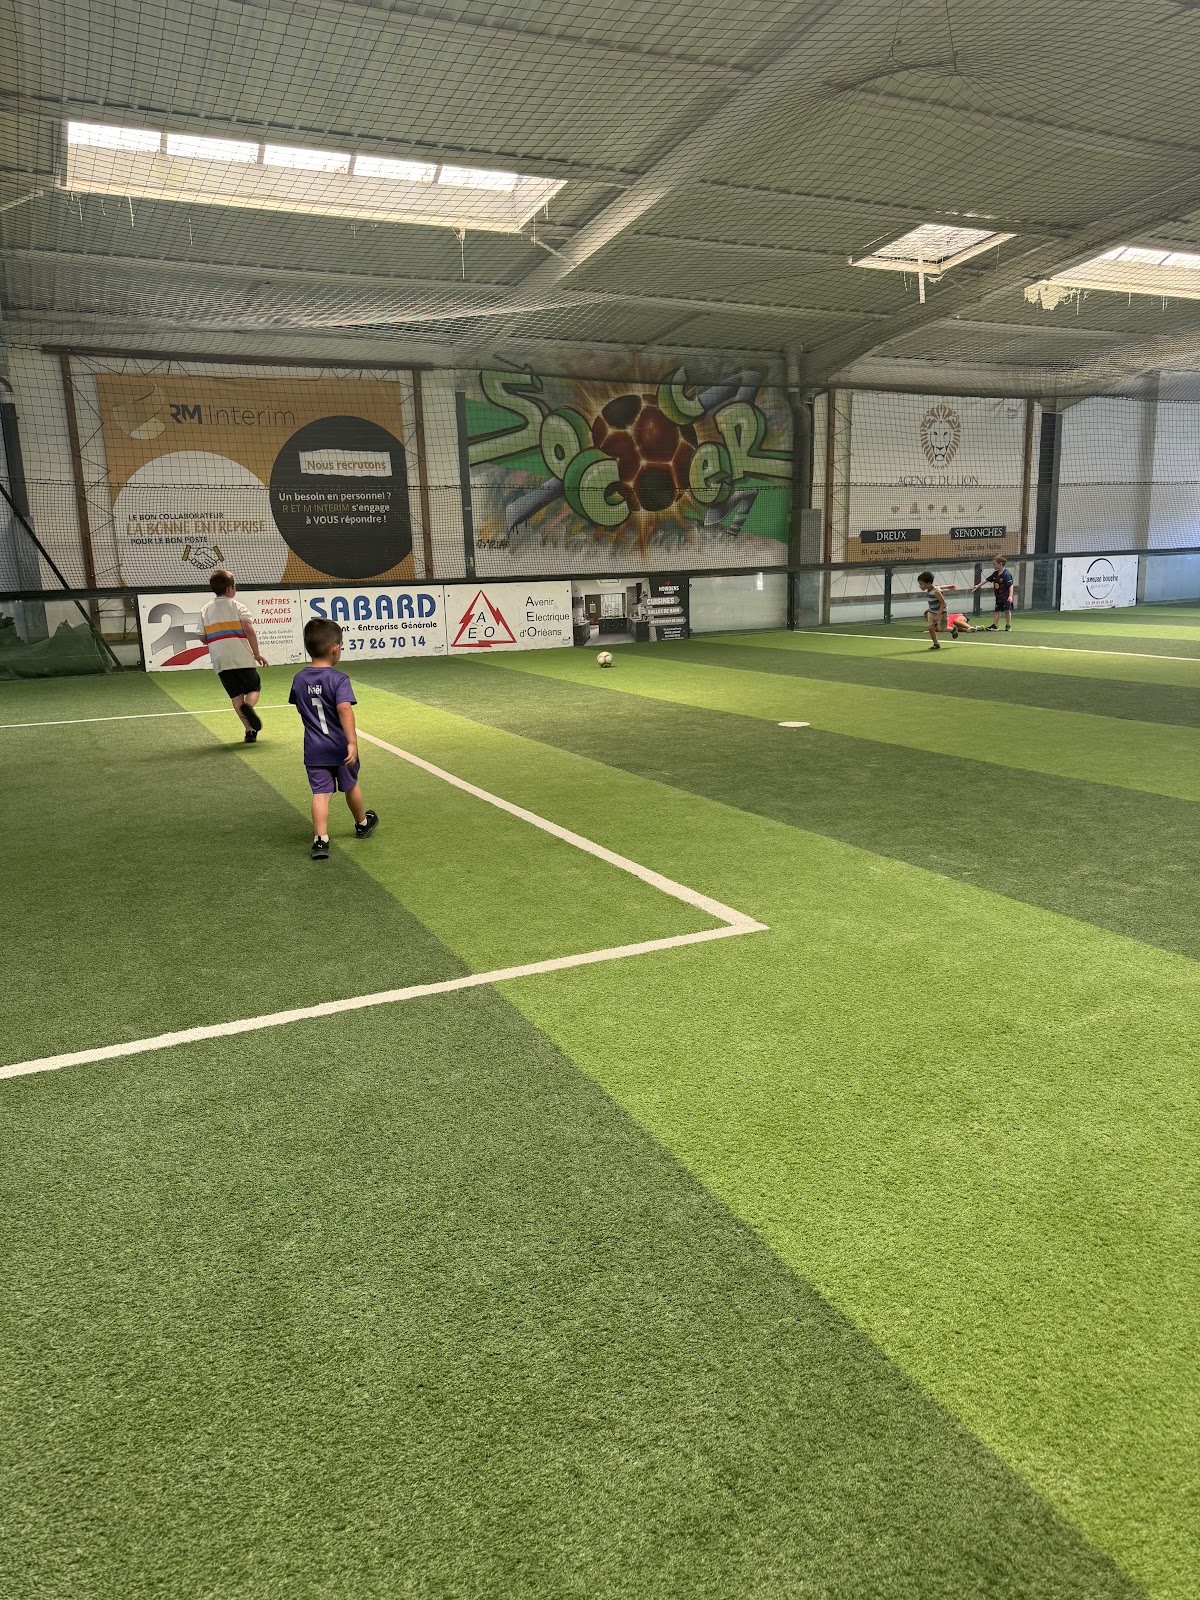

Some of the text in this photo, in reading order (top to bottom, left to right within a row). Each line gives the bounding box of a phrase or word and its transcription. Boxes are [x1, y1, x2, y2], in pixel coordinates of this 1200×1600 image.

[169, 404, 296, 426] RM Interim
[307, 461, 387, 470] Nous recrutons
[898, 475, 979, 486] AGENCE DU LION
[279, 493, 292, 501] Un
[294, 492, 325, 501] besoin
[340, 492, 385, 502] personnel
[282, 504, 390, 514] R ET M INTERIM s'engage
[159, 512, 224, 520] COLLABORATEUR
[306, 516, 312, 525] à
[313, 516, 339, 524] VOUS
[340, 515, 382, 525] répondre
[126, 520, 266, 536] LA BONNE ENTREPRISE
[954, 527, 1003, 538] SENONCHES
[184, 536, 208, 544] POSTE
[876, 531, 907, 541] DREUX
[525, 596, 554, 607] Avenir
[309, 594, 436, 622] SABARD
[253, 617, 292, 625] ALUMINIUM
[476, 612, 486, 623] A
[526, 611, 570, 622] Electrique
[358, 623, 399, 633] Entreprise
[401, 621, 437, 631] Générale
[468, 626, 495, 639] E O
[520, 626, 562, 638] d'Orléans
[349, 639, 365, 650] 37
[370, 638, 386, 649] 26
[390, 637, 406, 648] 70
[411, 636, 426, 647] 14
